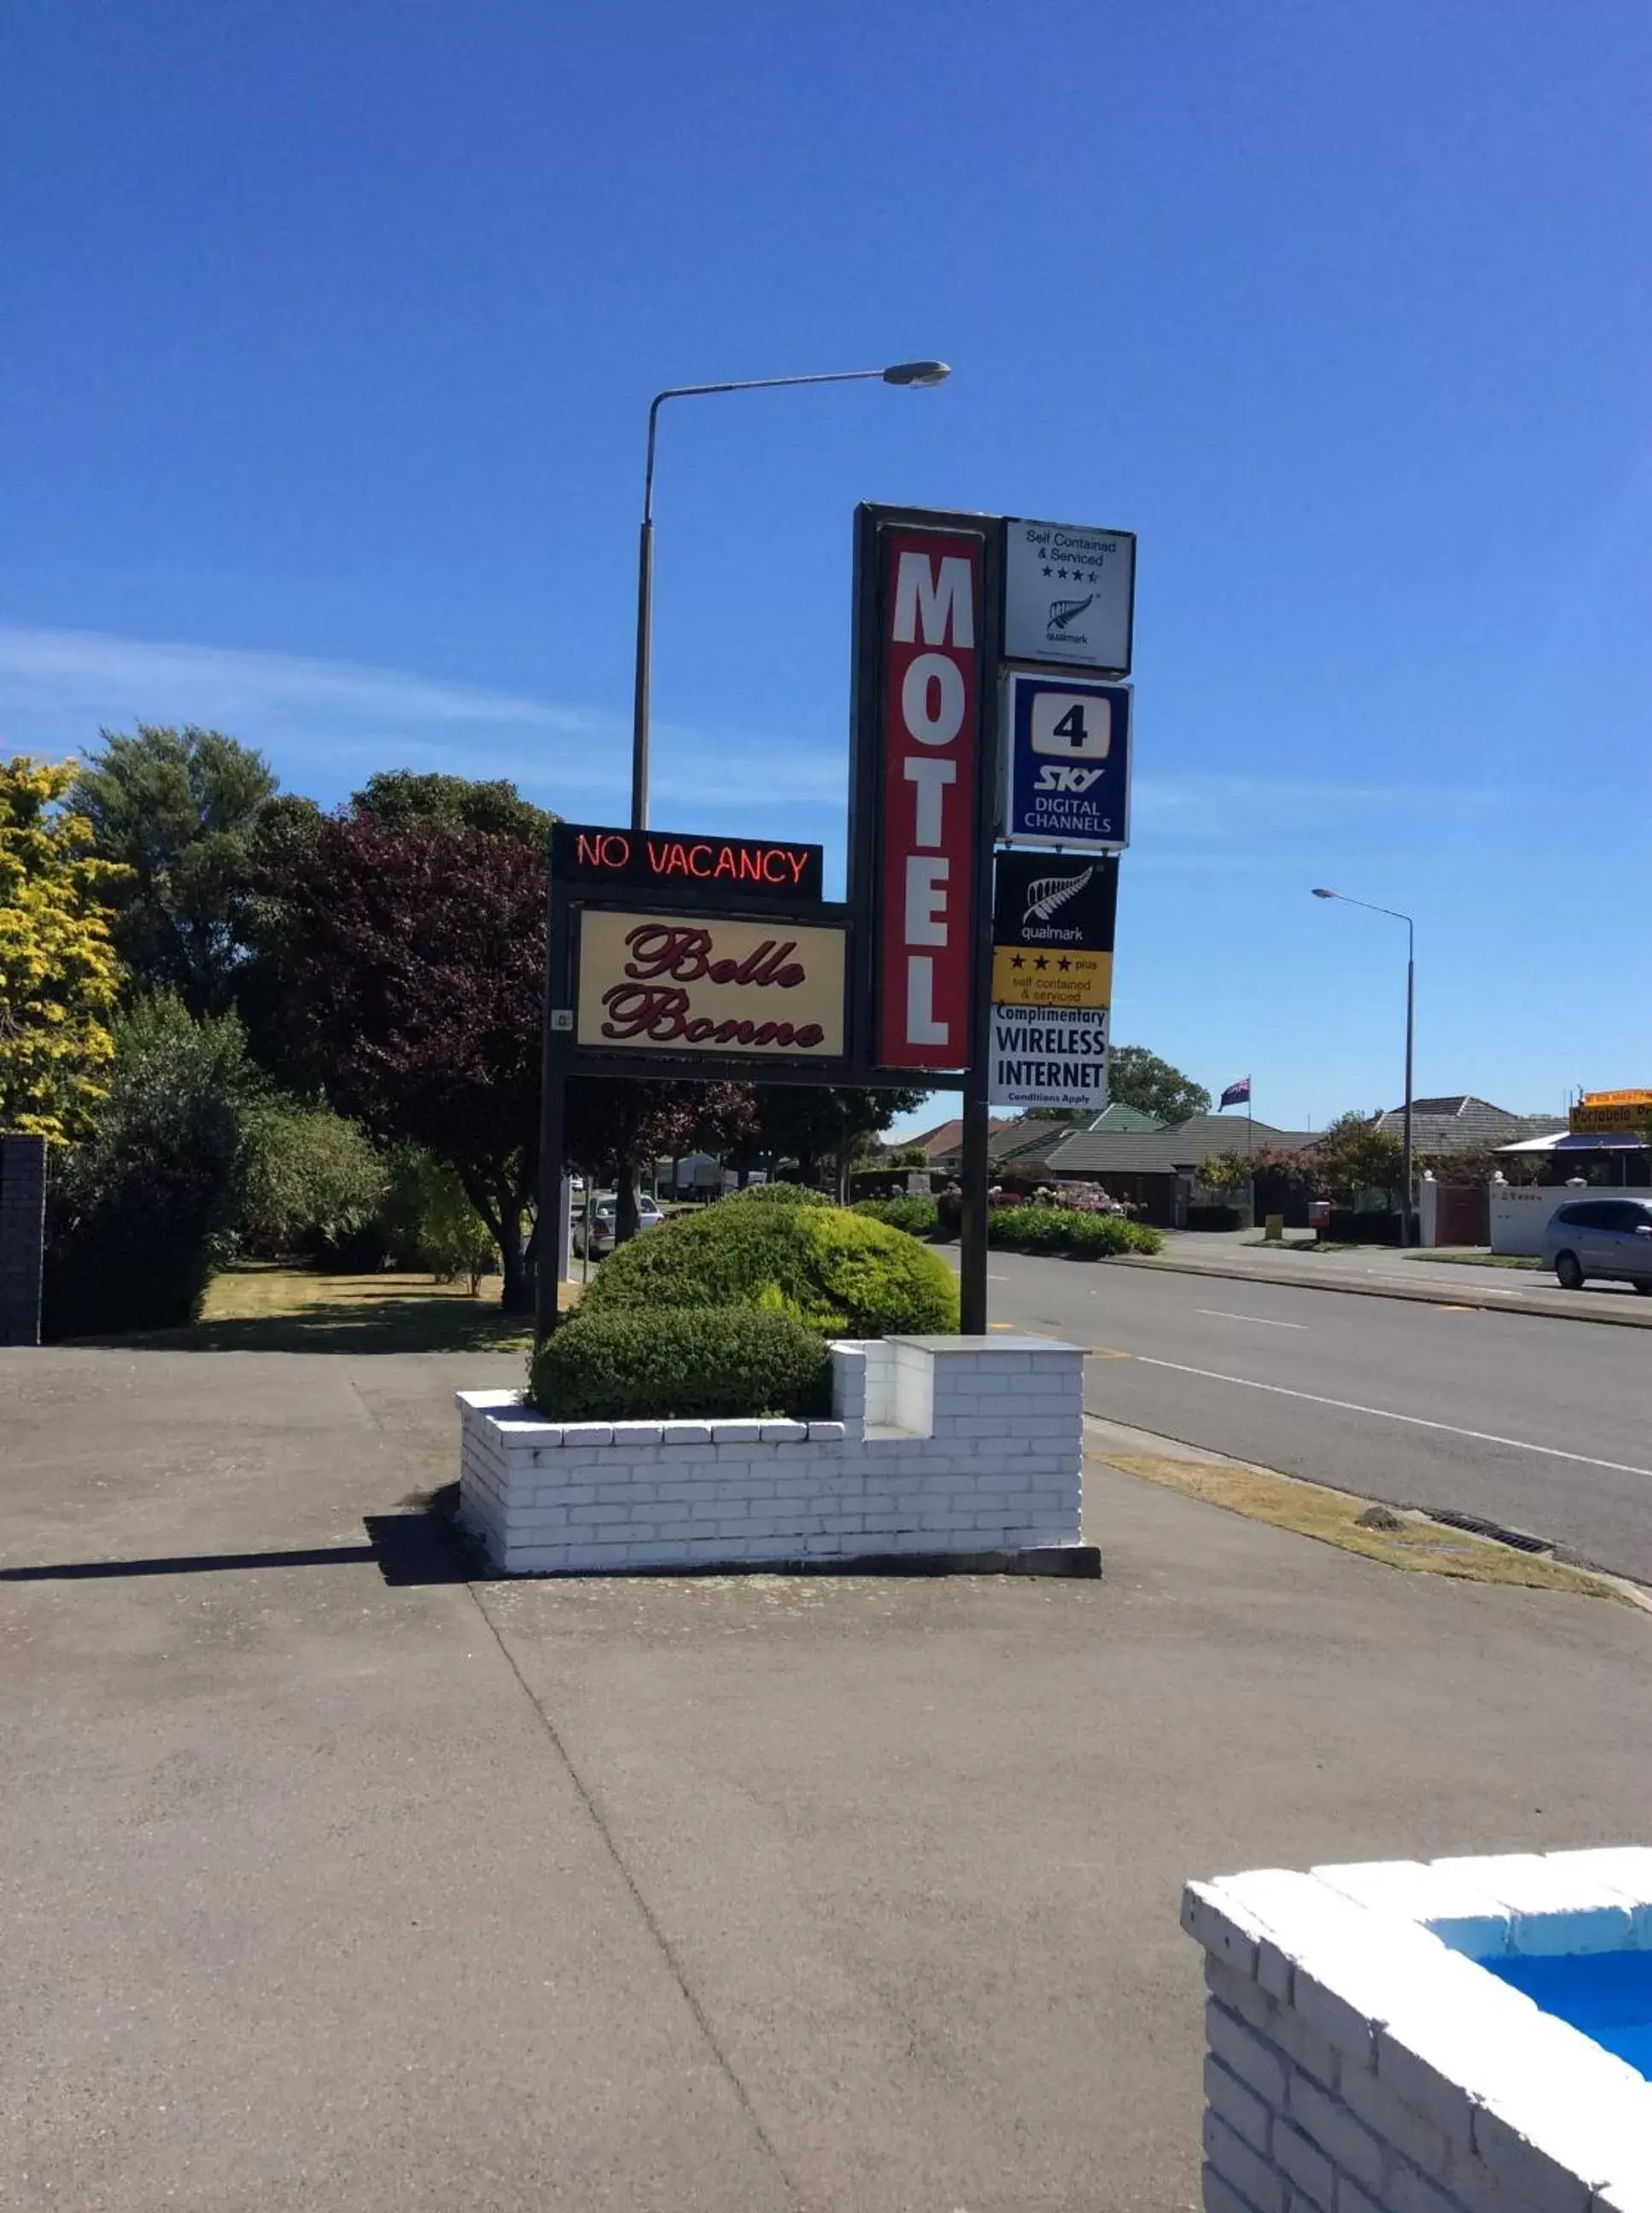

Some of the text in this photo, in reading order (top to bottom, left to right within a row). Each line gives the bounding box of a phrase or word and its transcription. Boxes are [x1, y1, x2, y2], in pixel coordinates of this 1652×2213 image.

[1026, 528, 1117, 552] Self Contained
[1038, 546, 1104, 567] & Serviced
[1053, 704, 1087, 747] 4
[1033, 765, 1106, 792] SKY
[892, 552, 975, 1046] MOTEL
[1036, 797, 1100, 816] DIGITAL
[1024, 812, 1111, 832] CHANNELS
[577, 833, 808, 885] NO VACANCY
[1022, 925, 1083, 942] qualmark
[625, 923, 806, 989] Belle
[1076, 959, 1098, 971] plus
[1013, 976, 1091, 991] self contained
[1020, 989, 1082, 1002] & serviced
[601, 982, 825, 1048] Bonne
[996, 1005, 1106, 1027] Complimentary
[996, 1026, 1105, 1055] WIRELESS
[998, 1060, 1104, 1089] INTERNET
[1008, 1091, 1090, 1105] Conditions Apply
